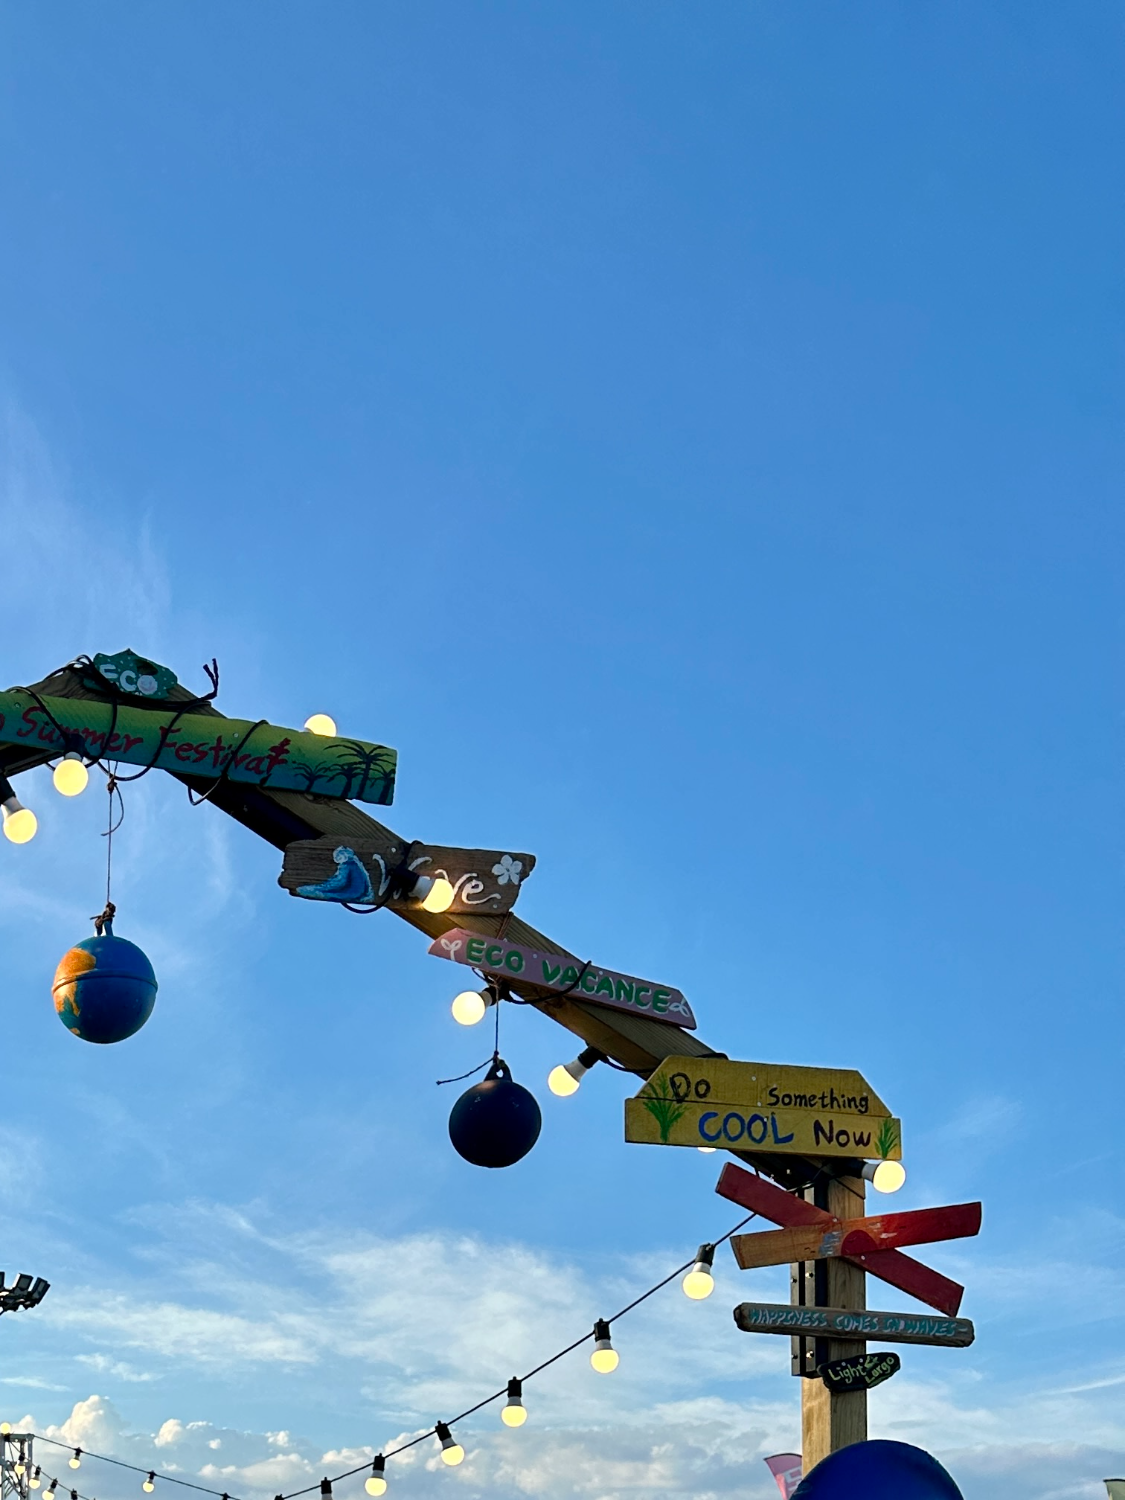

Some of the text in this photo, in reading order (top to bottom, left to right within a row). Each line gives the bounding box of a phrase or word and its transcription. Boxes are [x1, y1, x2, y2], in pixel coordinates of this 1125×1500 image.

[99, 664, 158, 695] ECO
[465, 938, 672, 1013] ECO VACANCE
[670, 1071, 870, 1114] Do Something
[698, 1110, 872, 1148] COOL Now
[748, 1308, 828, 1328] HAPPINESS
[834, 1314, 880, 1333] COMES
[827, 1363, 866, 1384] Light
